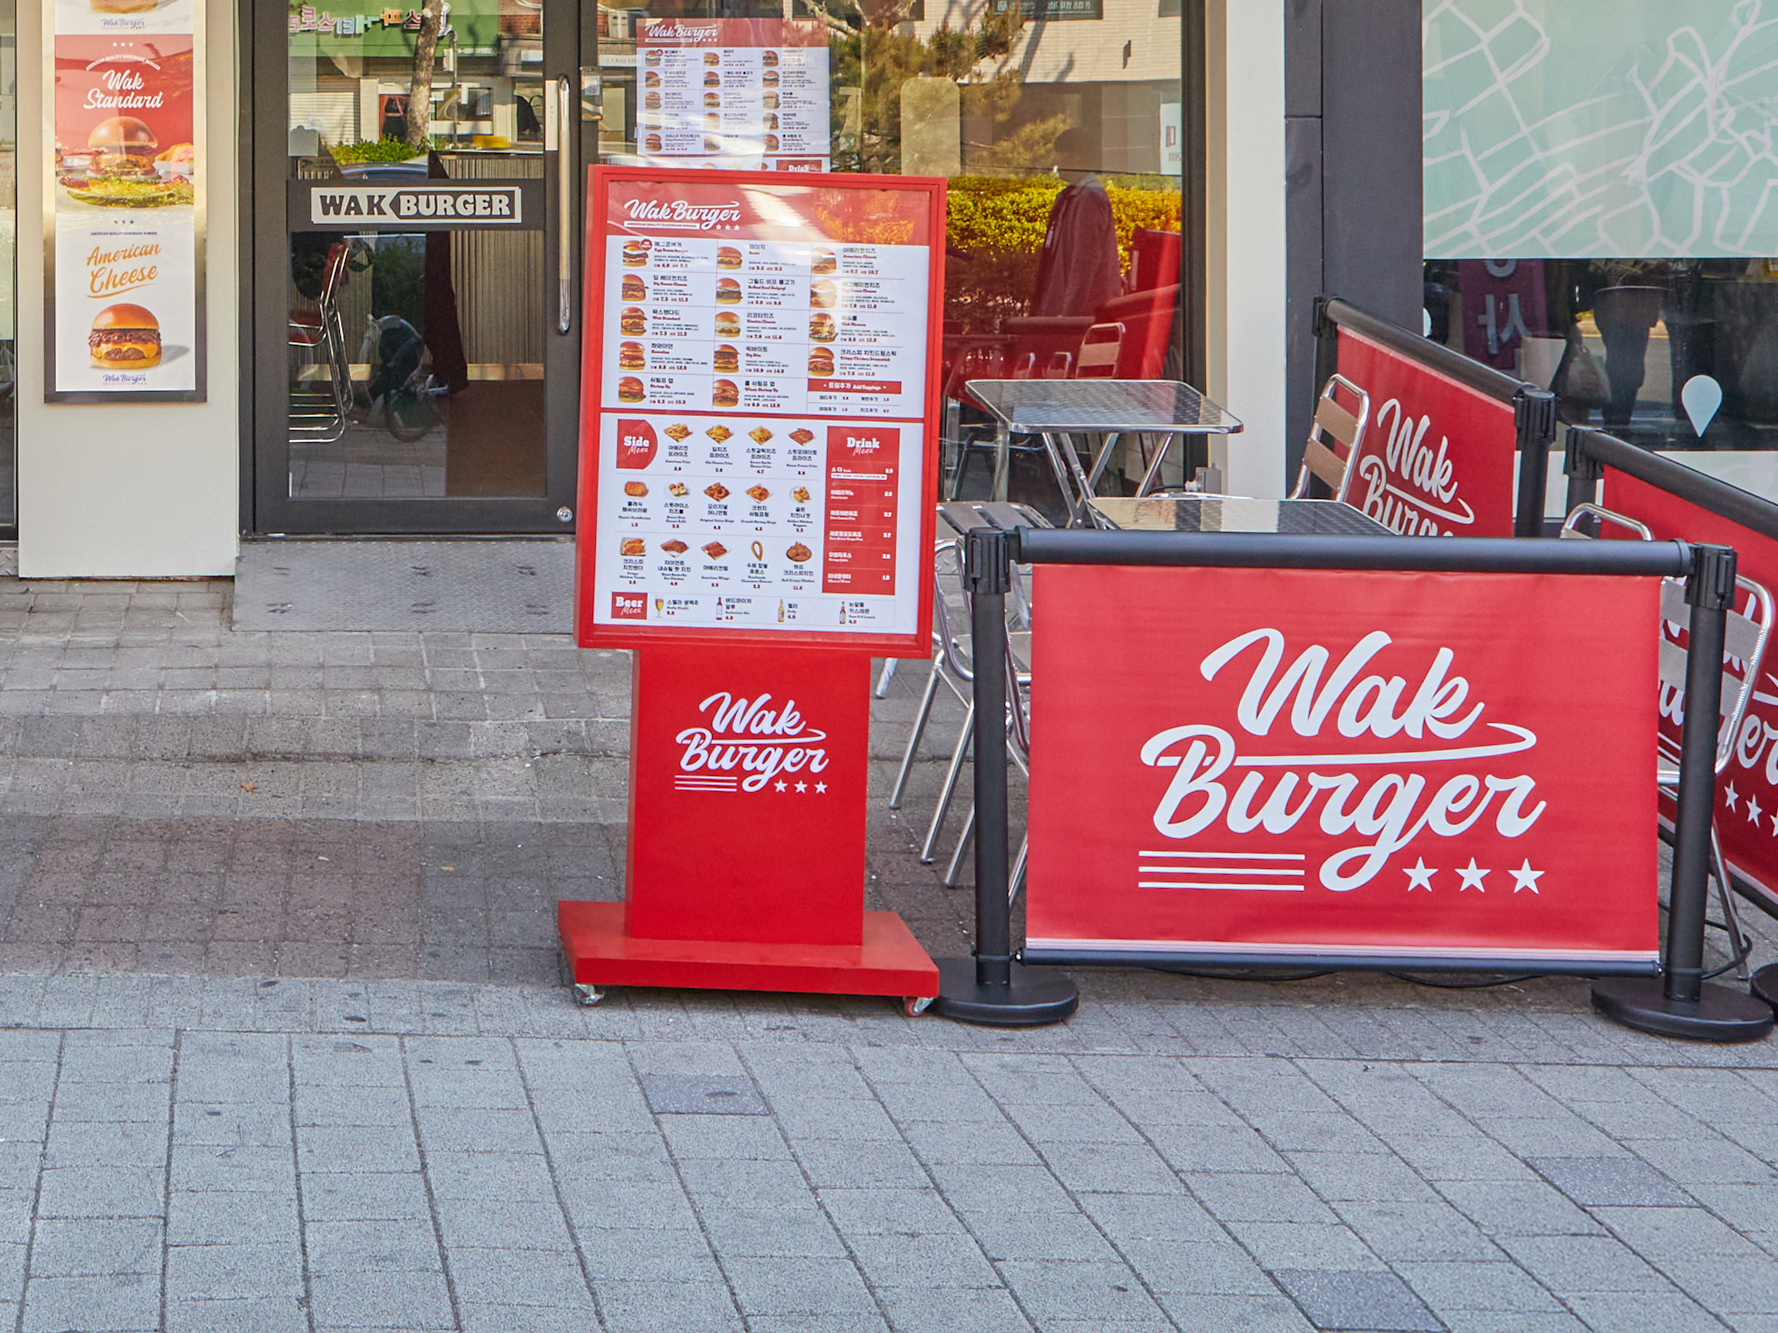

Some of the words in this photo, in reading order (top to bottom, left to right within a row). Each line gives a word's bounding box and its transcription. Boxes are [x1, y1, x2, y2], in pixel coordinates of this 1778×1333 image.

[645, 23, 675, 39] Wak
[674, 23, 718, 43] Burger
[102, 69, 145, 91] Wak
[83, 88, 164, 110] Standard
[319, 194, 392, 217] WAK
[399, 193, 513, 216] BURGER
[624, 199, 673, 220] Wak
[671, 200, 741, 230] Burger
[86, 243, 161, 267] American
[89, 265, 160, 294] Cheese
[623, 435, 650, 447] Side
[846, 437, 881, 449] Drink
[1377, 398, 1458, 504] Wak
[615, 596, 644, 608] Beer
[1200, 628, 1486, 741] Wak
[698, 691, 807, 735] Wak
[675, 727, 830, 793] Burger
[1139, 722, 1547, 892] Burger
